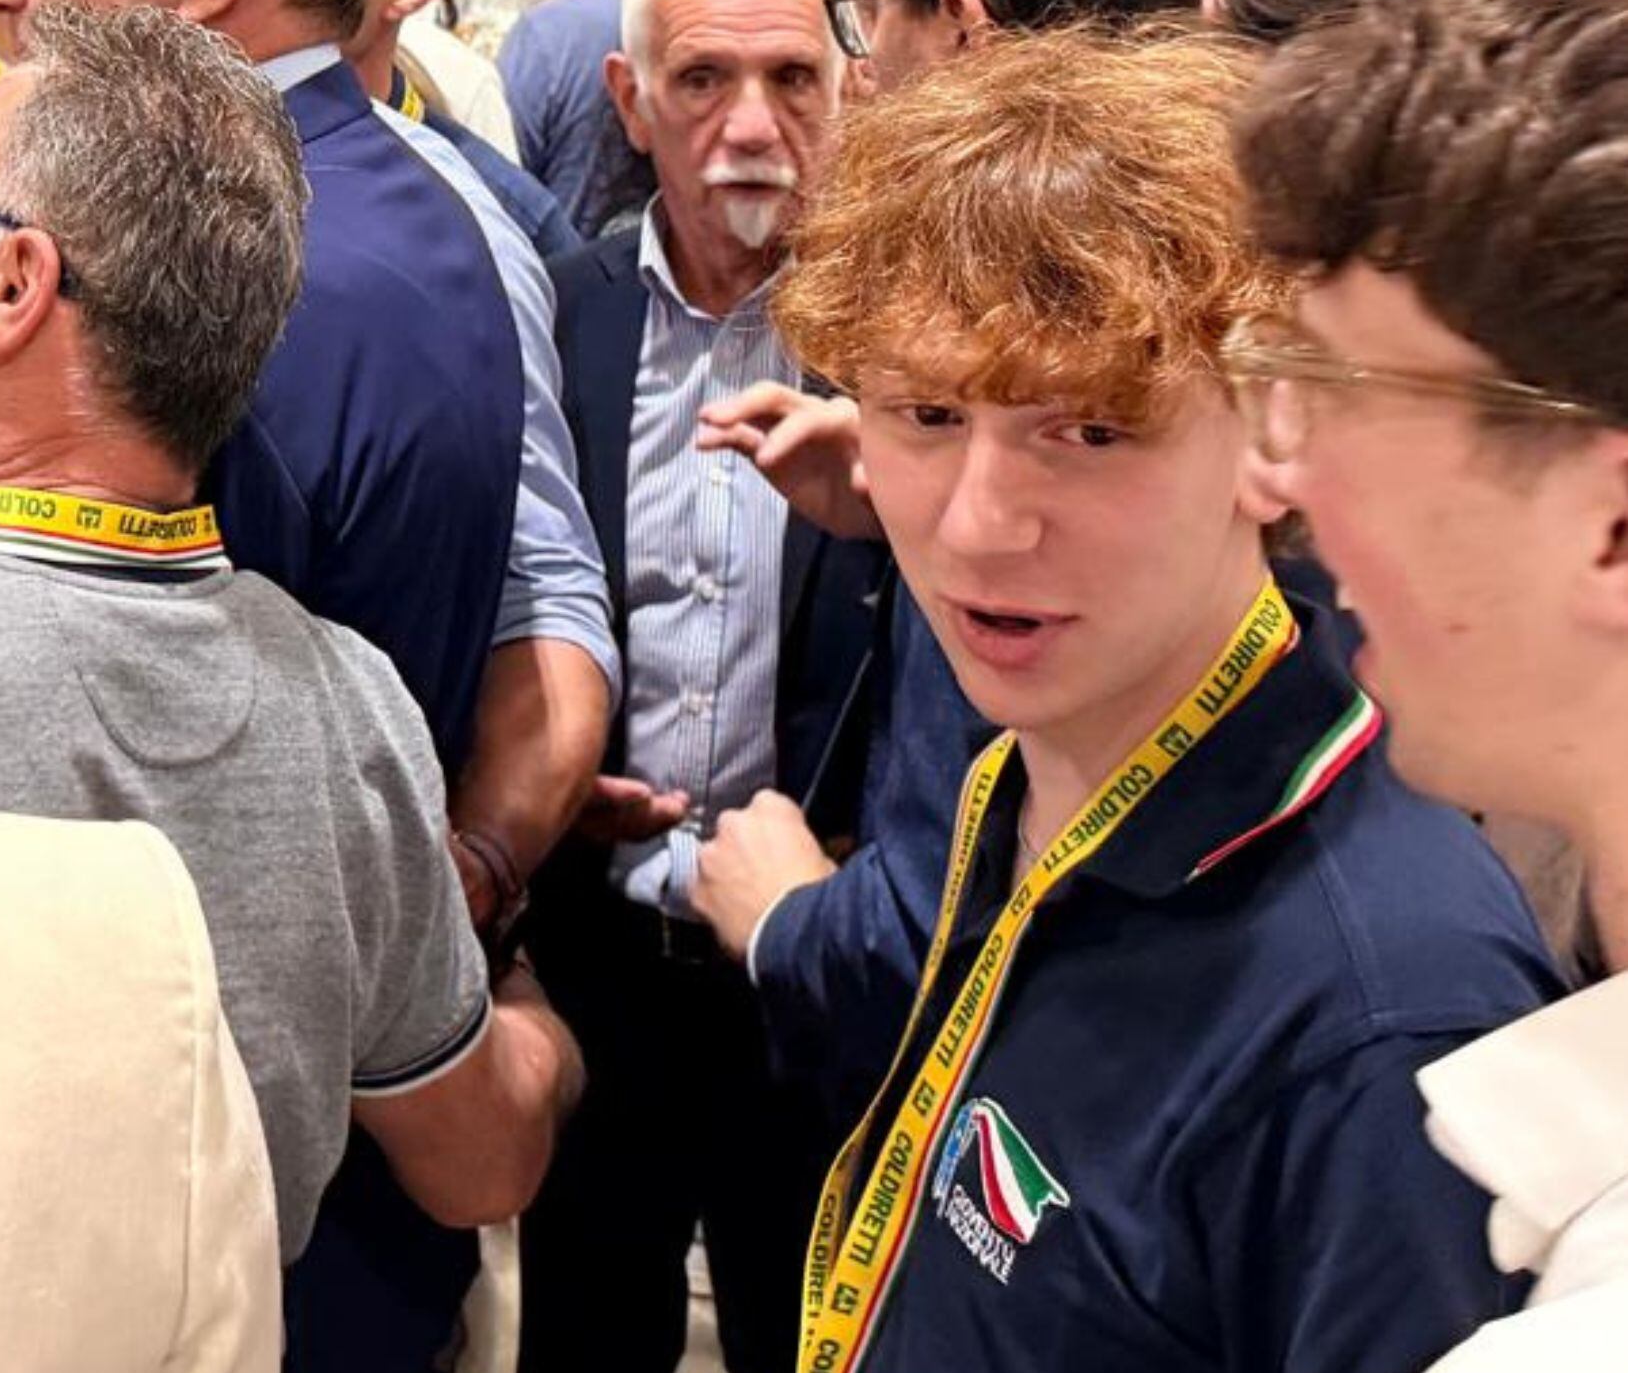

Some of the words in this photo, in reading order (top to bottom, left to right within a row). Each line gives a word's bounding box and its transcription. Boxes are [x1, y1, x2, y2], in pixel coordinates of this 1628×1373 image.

[118, 510, 198, 538] COLDIRETTI
[1196, 598, 1283, 716] COLDIRETTI
[1042, 764, 1153, 873] COLDIRETTI
[936, 933, 1005, 1069] COLDIRETTI
[849, 1129, 915, 1267] COLDIRETTI
